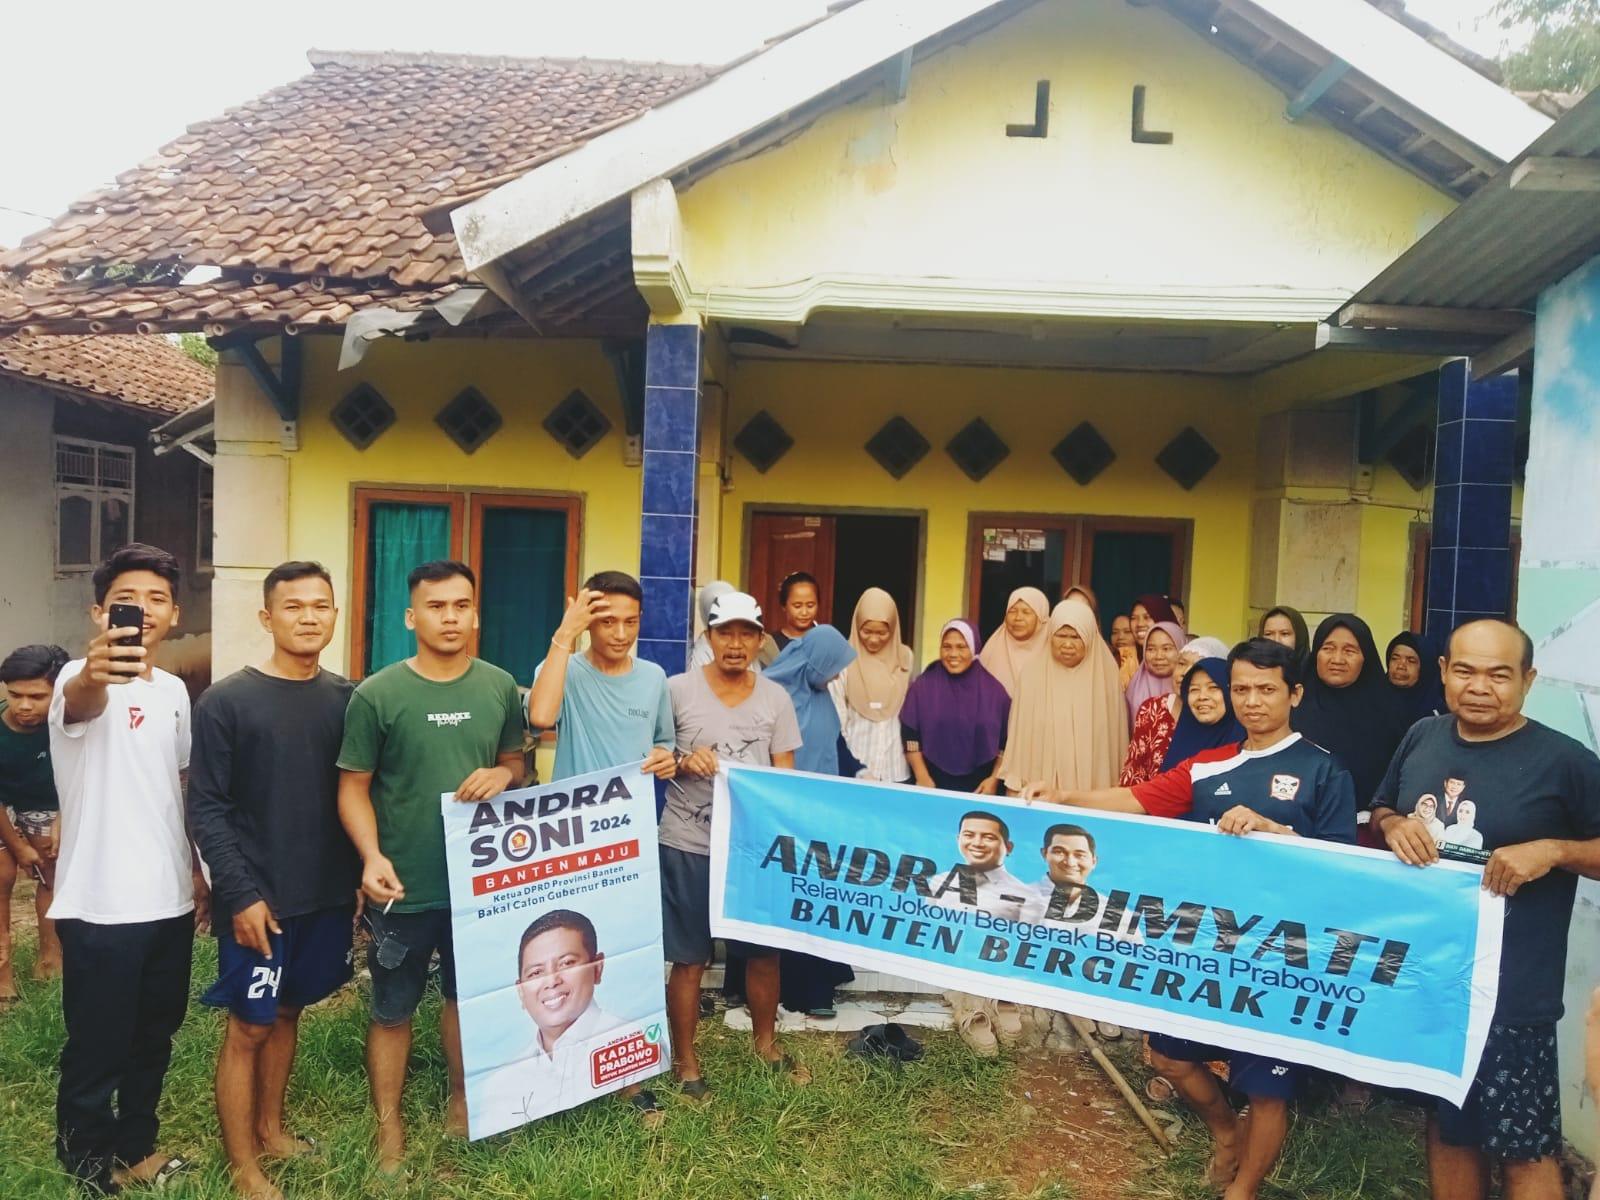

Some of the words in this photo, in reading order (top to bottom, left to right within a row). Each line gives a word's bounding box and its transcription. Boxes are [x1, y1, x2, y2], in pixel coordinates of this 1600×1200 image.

[468, 776, 633, 834] ANDRA
[471, 816, 585, 868] SONI
[590, 813, 632, 833] 2024
[485, 855, 569, 889] BANTEN
[577, 846, 630, 868] MAJU
[493, 889, 522, 903] Ketua
[524, 882, 550, 896] DPRD
[552, 872, 591, 889] Provinsi
[592, 865, 624, 879] Banten
[478, 903, 511, 919] Bakal
[512, 895, 545, 910] Calon
[547, 882, 600, 901] Gubernur
[601, 872, 639, 888] Banten
[760, 835, 979, 906] ANDRA
[1044, 882, 1411, 988] DIMYATI
[791, 877, 884, 910] Relawan
[889, 895, 969, 926] Jokowi
[975, 911, 1088, 948] Bergerak
[1096, 928, 1220, 974] Bersama
[1229, 958, 1366, 1004] Prabowo
[247, 966, 283, 999] 24
[790, 898, 964, 955] BANTEN
[978, 934, 1269, 1019] BERGERAK
[1290, 995, 1360, 1037] !!!
[599, 1039, 644, 1063] KADER
[600, 1047, 653, 1075] PRABOWO
